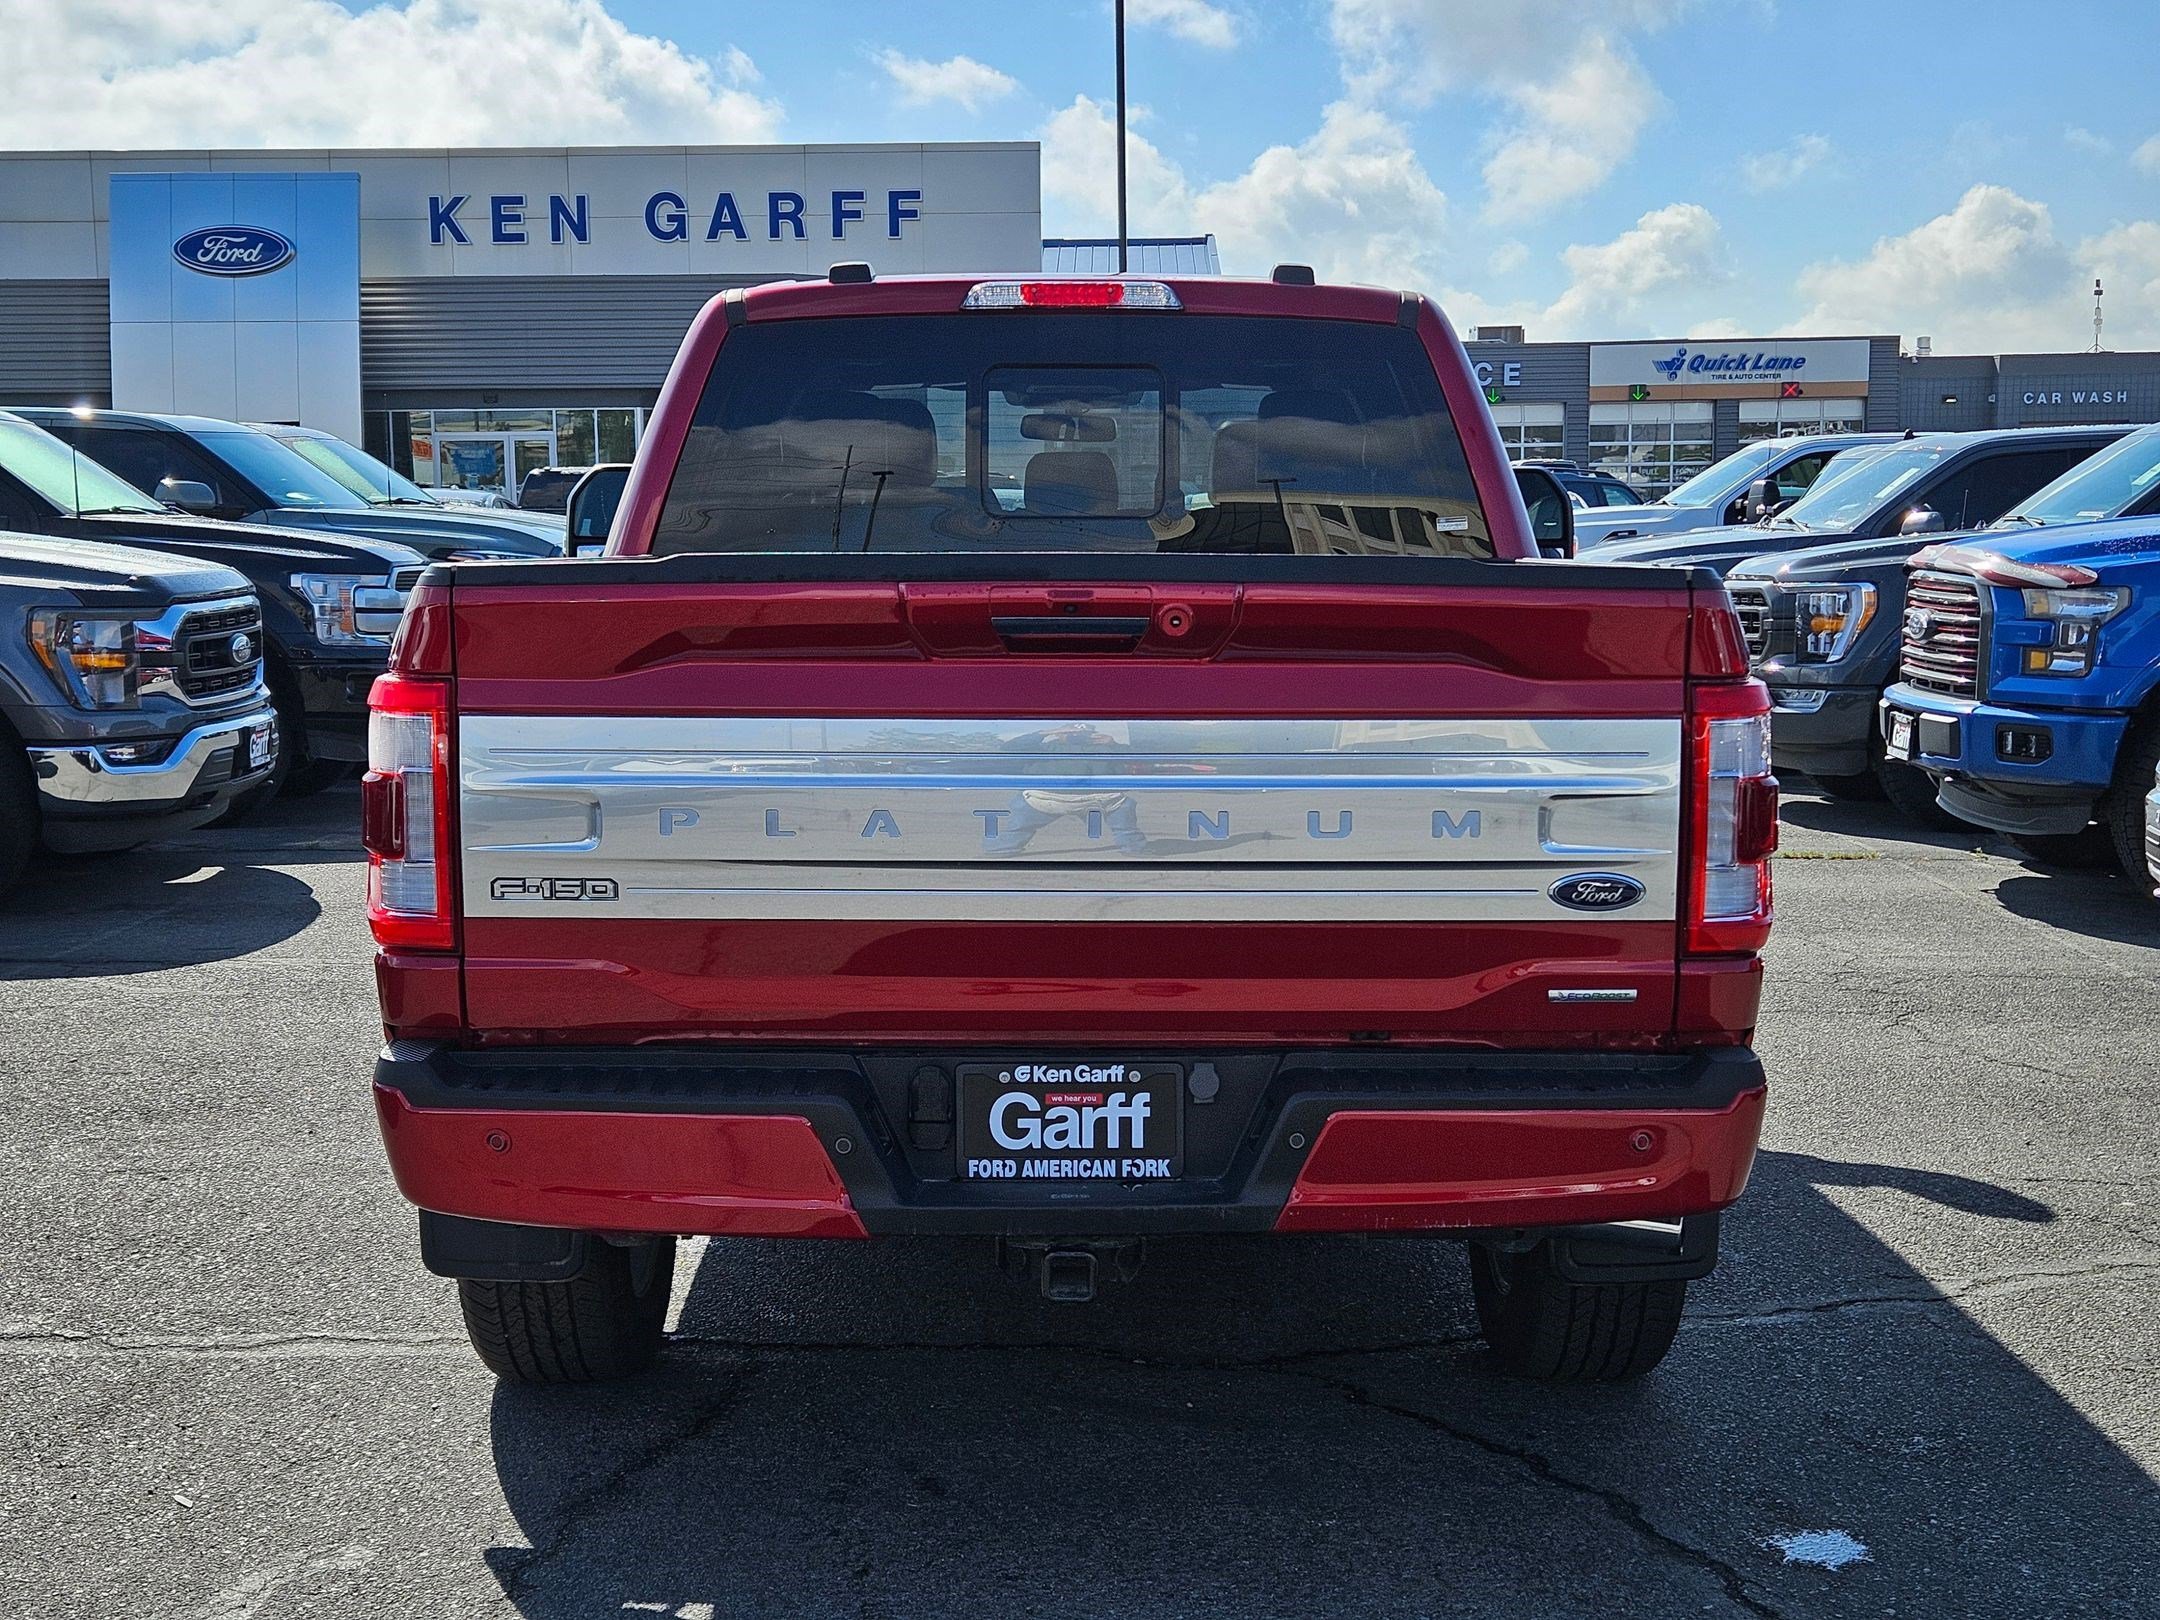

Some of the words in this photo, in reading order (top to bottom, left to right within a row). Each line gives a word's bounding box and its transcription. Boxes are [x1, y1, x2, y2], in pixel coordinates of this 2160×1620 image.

[428, 194, 590, 244] KEN
[644, 189, 922, 242] GARFF
[197, 235, 264, 262] Ford
[1688, 353, 1751, 374] Quick
[1752, 353, 1807, 371] Lane
[1754, 372, 1782, 380] CENTER
[2023, 392, 2062, 405] CAR
[2072, 390, 2127, 404] WASH
[658, 808, 1482, 839] PLATINUM
[490, 876, 620, 902] F-150
[1572, 881, 1624, 903] Ford
[1033, 1065, 1072, 1083] Ken
[1074, 1065, 1125, 1083] Garff
[1064, 1094, 1081, 1102] hear
[1082, 1095, 1097, 1105] you
[989, 1092, 1151, 1150] Garff
[968, 1159, 1017, 1178] FORD
[1022, 1159, 1116, 1178] AMERICAN
[1122, 1158, 1171, 1178] FORK
